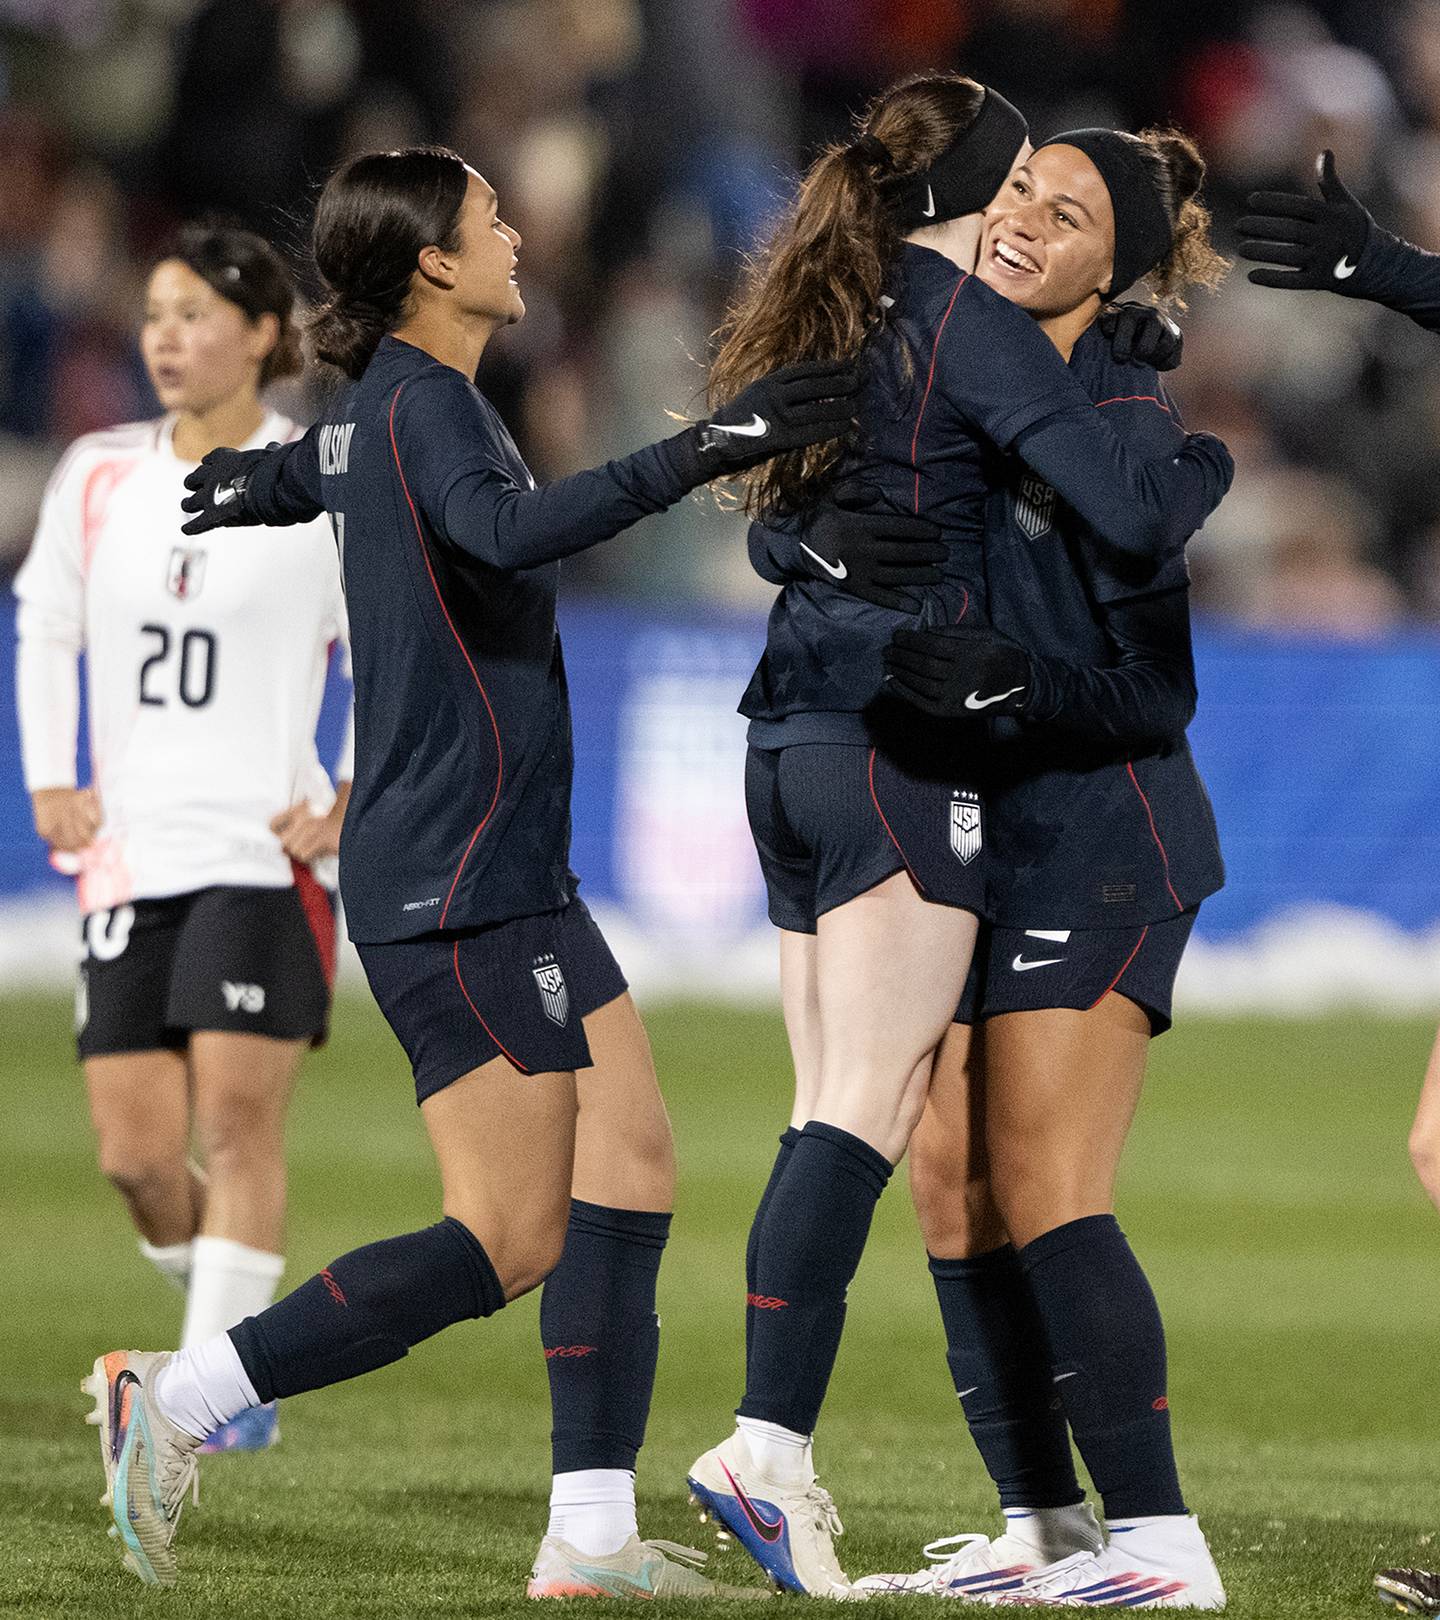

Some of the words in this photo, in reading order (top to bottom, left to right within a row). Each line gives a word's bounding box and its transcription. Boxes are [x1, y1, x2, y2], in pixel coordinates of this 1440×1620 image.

[138, 622, 218, 709] 20
[953, 804, 979, 831] USA
[536, 967, 563, 993] USA
